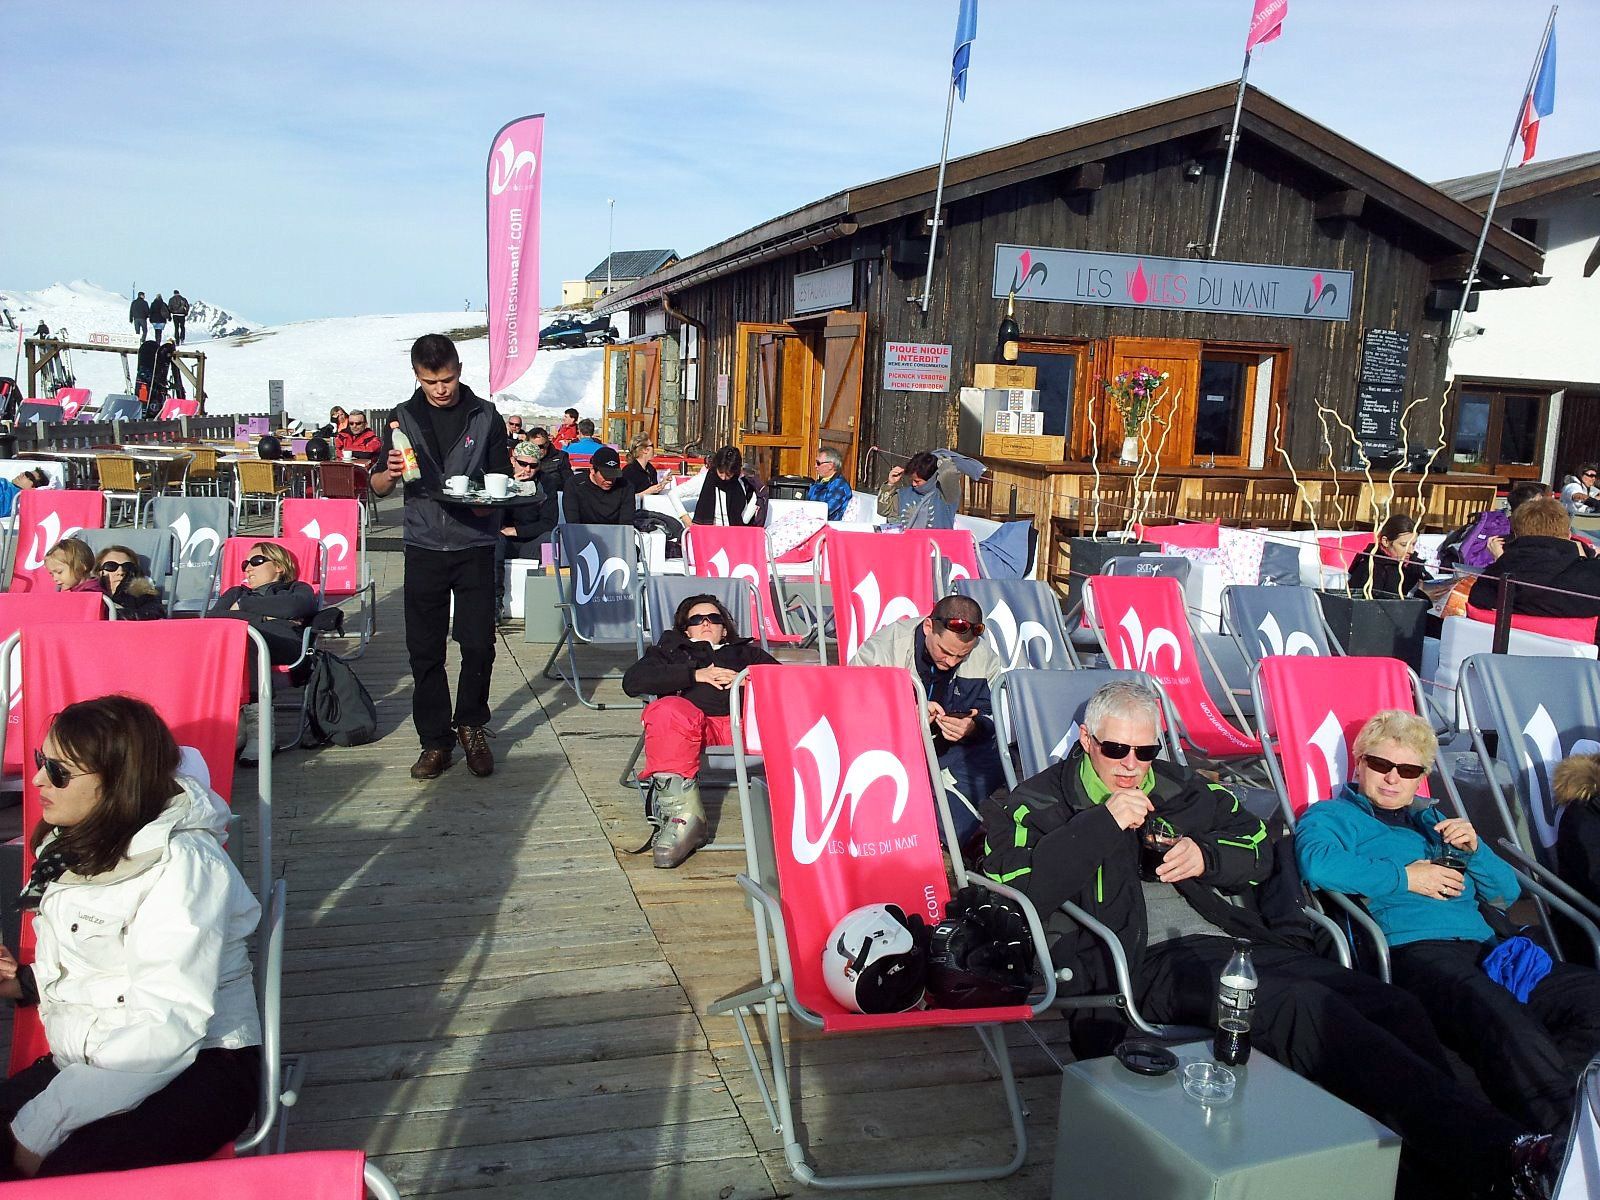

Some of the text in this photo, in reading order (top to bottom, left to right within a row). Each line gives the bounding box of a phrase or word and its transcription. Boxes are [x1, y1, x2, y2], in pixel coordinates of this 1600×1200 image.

[506, 208, 522, 359] lesvoilesdunant.com
[1076, 267, 1113, 298] LES
[1197, 276, 1223, 306] DU
[1232, 279, 1280, 310] NANT
[889, 346, 948, 355] PIQUE NIQUE
[897, 354, 940, 363] INTERDIT
[828, 840, 845, 854] LES
[879, 840, 892, 855] DU
[895, 834, 918, 851] NANT
